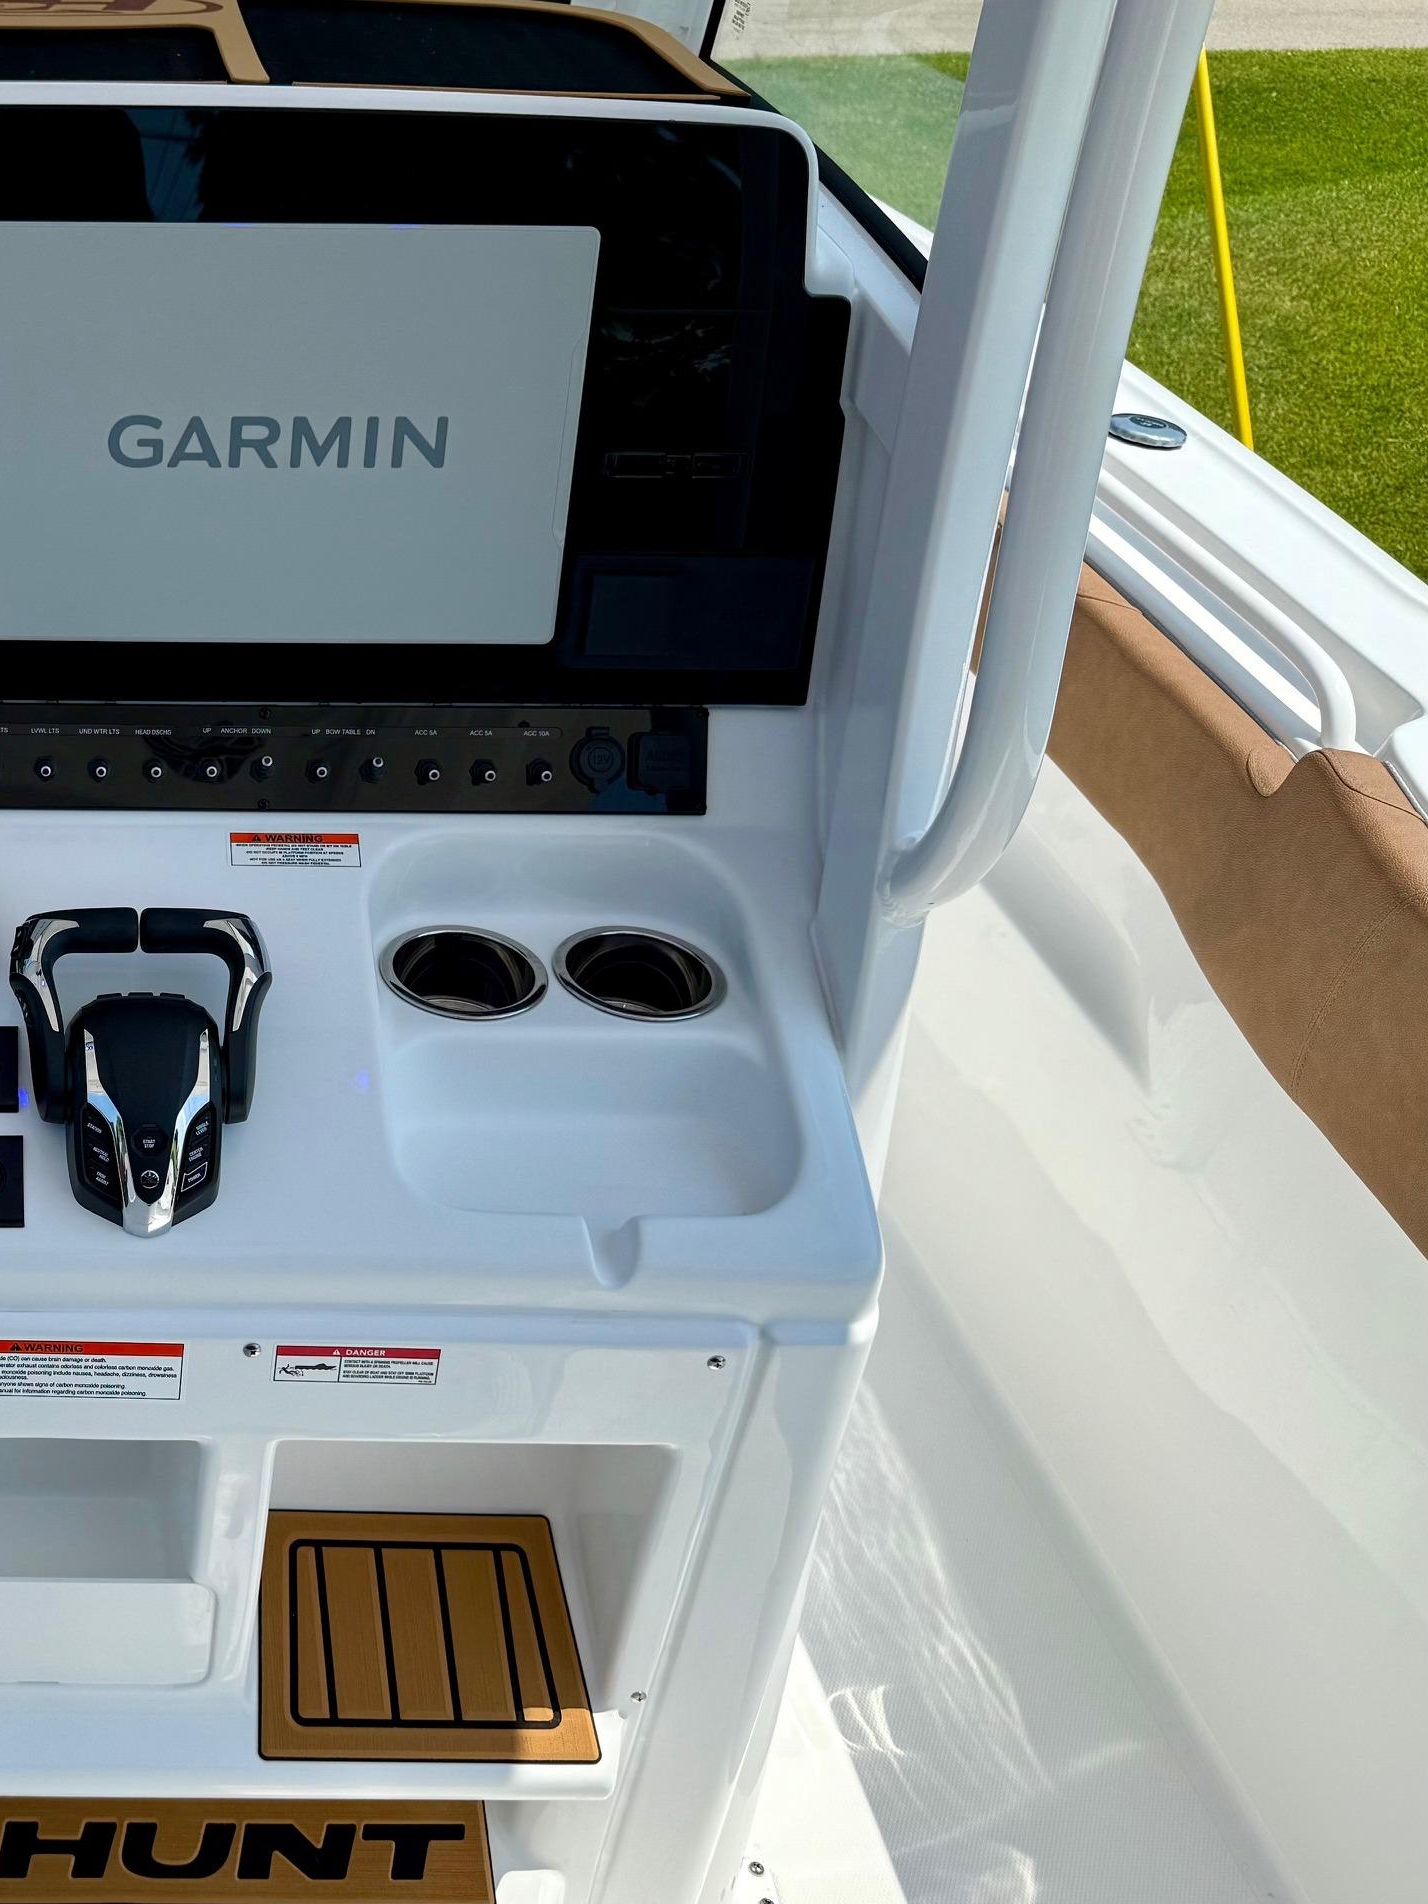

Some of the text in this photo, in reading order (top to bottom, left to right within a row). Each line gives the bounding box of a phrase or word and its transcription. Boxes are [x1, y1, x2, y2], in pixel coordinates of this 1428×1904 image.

[108, 414, 449, 469] GARMIN
[265, 834, 324, 843] WARNING
[25, 1344, 83, 1352] WARNING
[346, 1349, 386, 1357] DANGER
